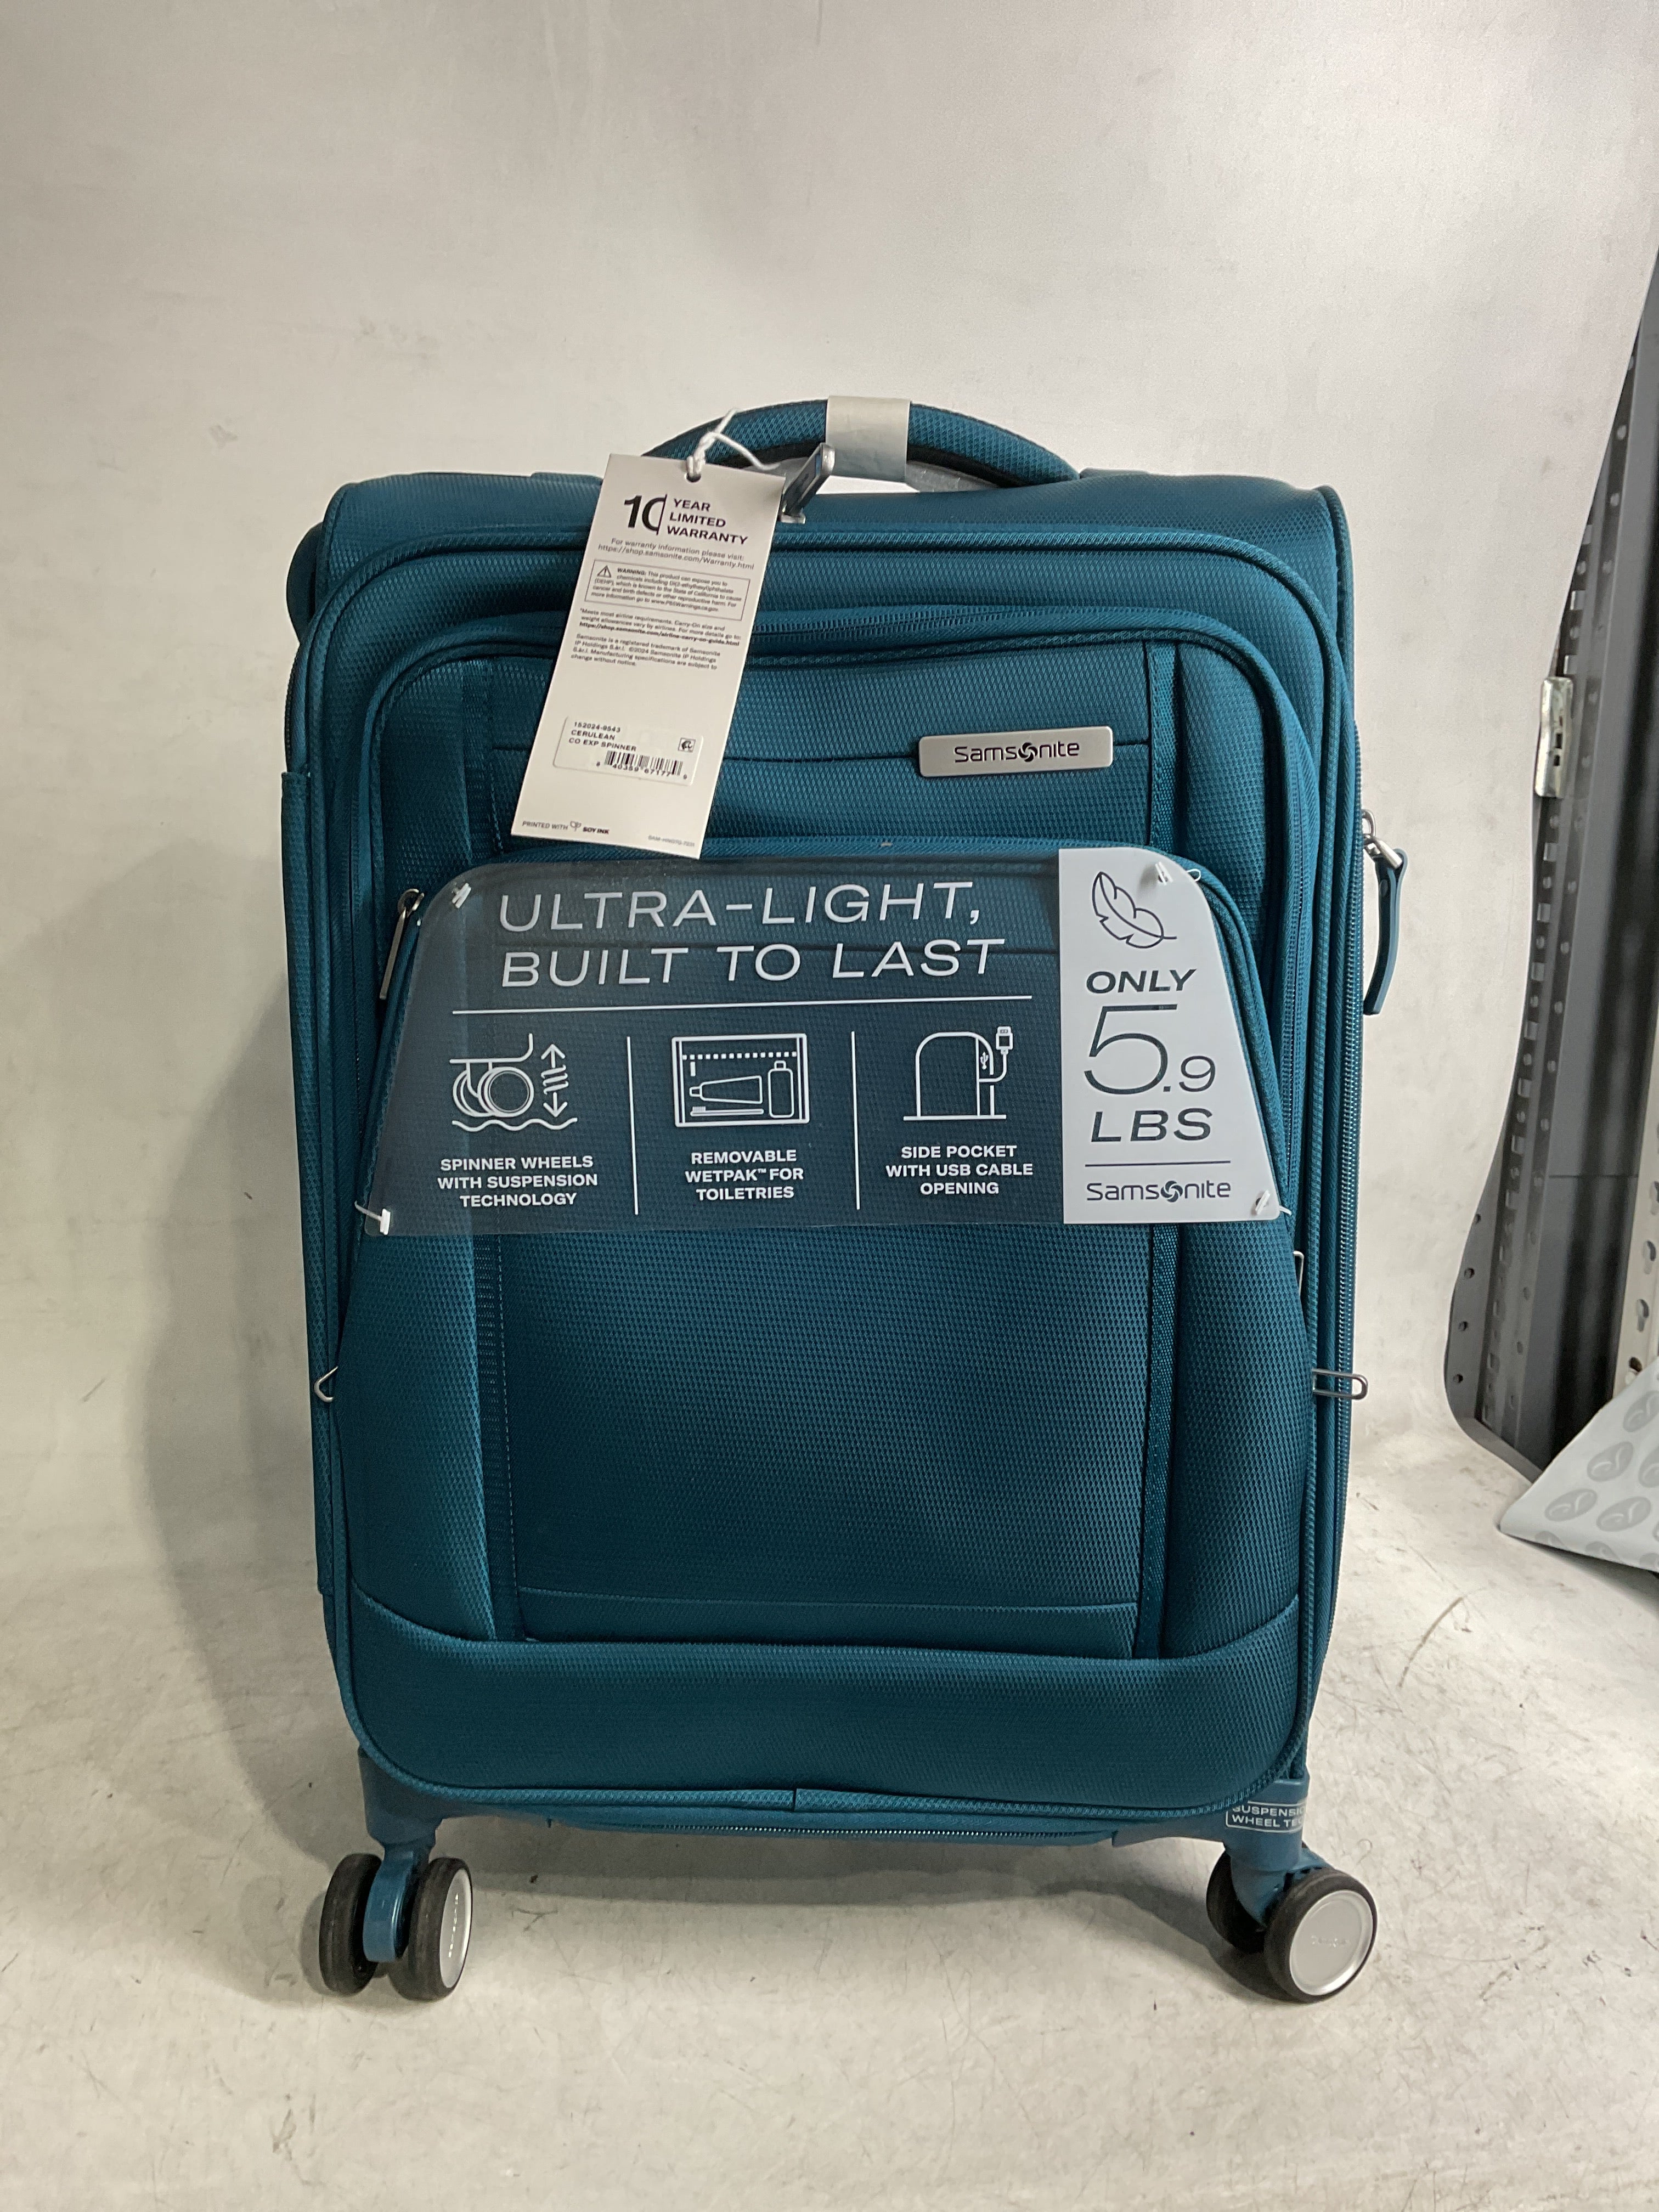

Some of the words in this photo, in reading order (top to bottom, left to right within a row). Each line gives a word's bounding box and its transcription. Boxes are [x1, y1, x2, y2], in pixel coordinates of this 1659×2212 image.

[674, 498, 710, 511] YEAR
[669, 512, 726, 527] LIMITED
[667, 525, 748, 544] WARRANTY
[625, 540, 656, 550] warranty
[658, 543, 699, 555] information
[701, 549, 725, 558] please
[727, 552, 744, 561] visit:
[644, 577, 668, 586] including
[678, 596, 710, 604] reproductive
[693, 590, 718, 599] California
[576, 633, 607, 641] Samsonite
[651, 643, 680, 651] trademark
[689, 647, 720, 656] Samsonite
[582, 641, 607, 650] Holdings
[650, 649, 681, 658] Samsonite
[690, 654, 716, 663] Holdings
[590, 648, 633, 659] Manufacturing
[634, 655, 675, 664] specifications
[571, 729, 615, 740] CERULEAN
[601, 741, 636, 751] SPINNER
[954, 741, 1080, 763] Samsonite
[522, 820, 550, 828] PRINTED
[500, 881, 979, 932] ULTRA-LIGHT,
[502, 947, 689, 987] BUILT
[717, 944, 800, 981] TO
[832, 939, 1005, 978] LAST
[1086, 968, 1197, 994] ONLY
[1084, 1003, 1216, 1095] 5.9
[1091, 1108, 1213, 1142] LBS
[691, 1149, 797, 1165] REMOVABLE
[901, 1146, 941, 1159] SIDE
[946, 1144, 1017, 1158] POCKET
[441, 1157, 516, 1171] SPINNER
[521, 1155, 594, 1169] WHEELS
[885, 1165, 931, 1178] WITH
[935, 1164, 971, 1177] USB
[975, 1163, 1033, 1176] CABLE
[437, 1176, 482, 1189] WITH
[487, 1173, 597, 1188] SUSPENSION
[770, 1168, 804, 1181] FOR
[696, 1186, 794, 1200] TOILETRIES
[920, 1182, 999, 1195] OPENING
[1086, 1180, 1231, 1203] Samsonite
[459, 1192, 577, 1207] TECHNOLOGY
[1232, 1814, 1280, 1827] WHEEL
